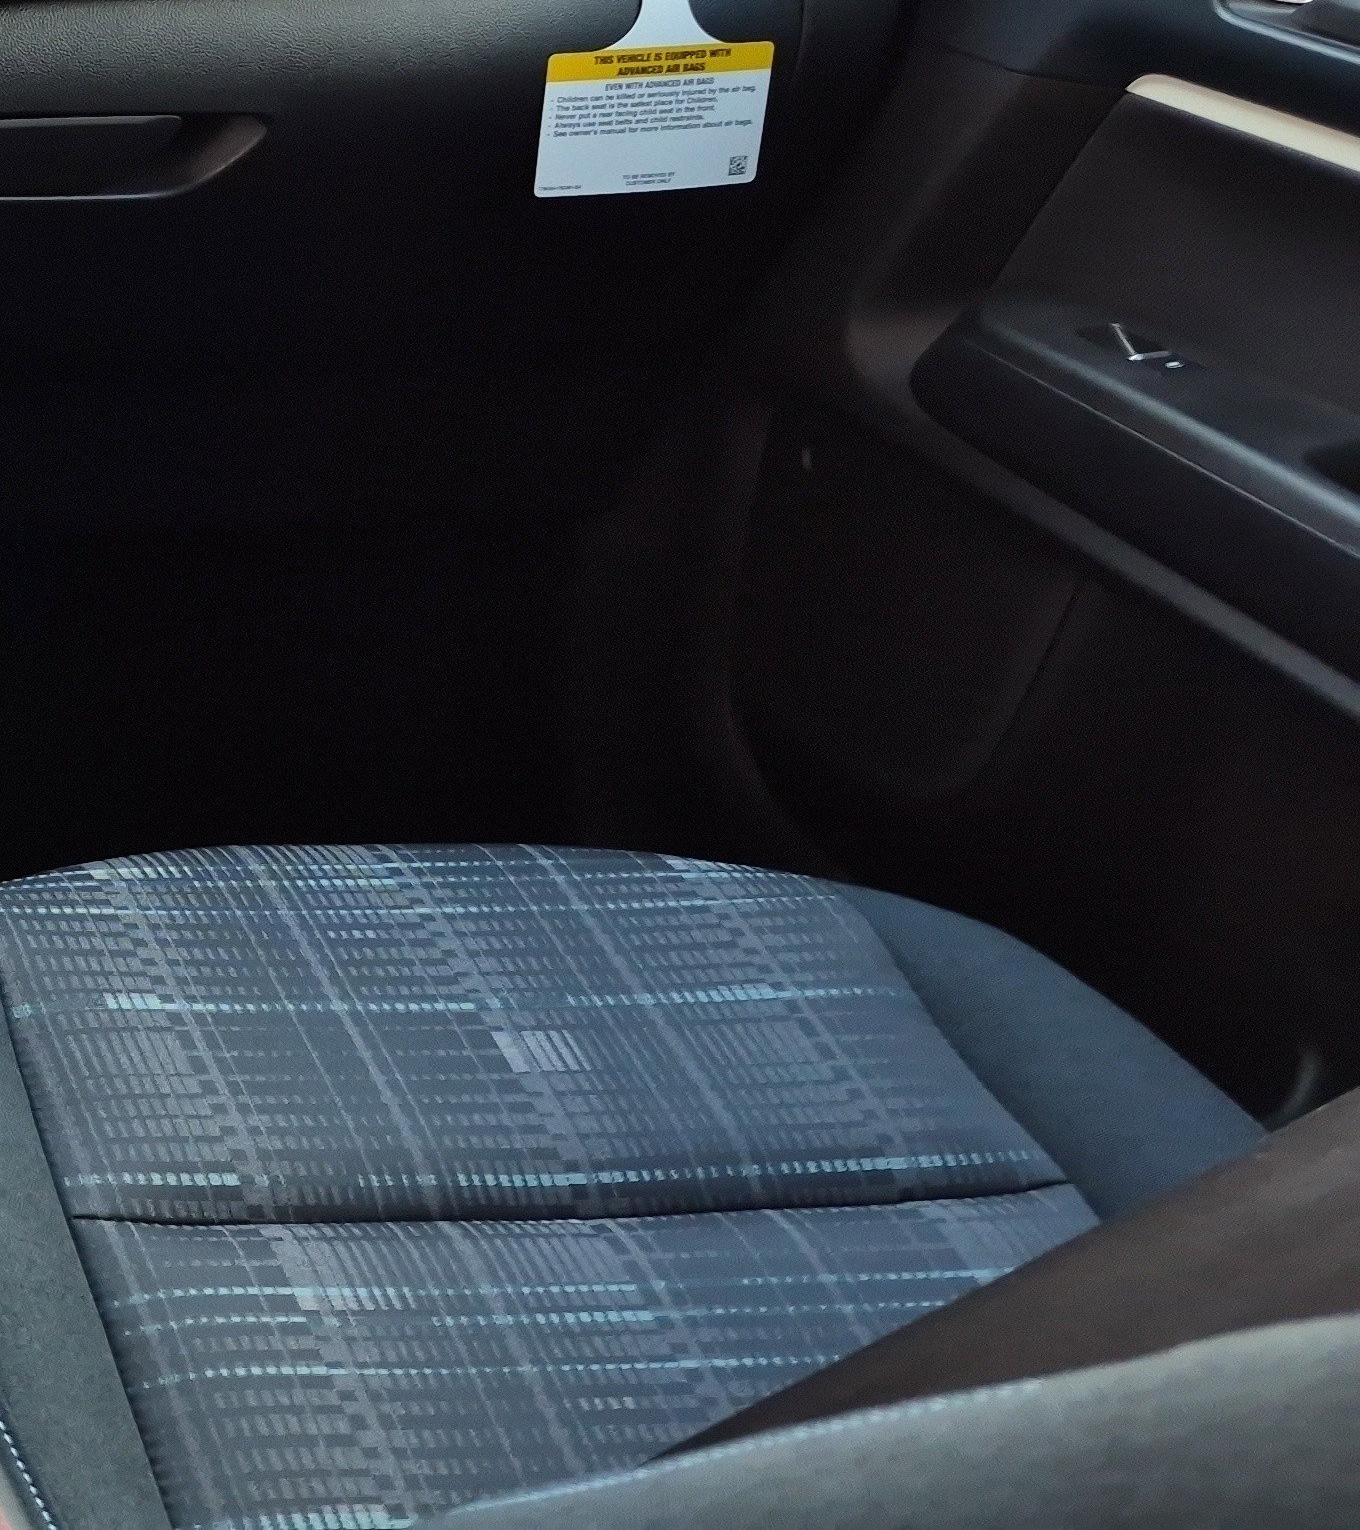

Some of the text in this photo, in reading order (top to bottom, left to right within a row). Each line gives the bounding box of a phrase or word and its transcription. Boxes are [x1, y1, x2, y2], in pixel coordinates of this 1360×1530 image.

[593, 48, 732, 65] THIS VEHICLE IS EQUIPPED WITH
[617, 65, 664, 76] ADVANCED
[666, 63, 681, 73] AIR
[605, 76, 715, 91] EVEN WITH ADVANCED AIR BAGS
